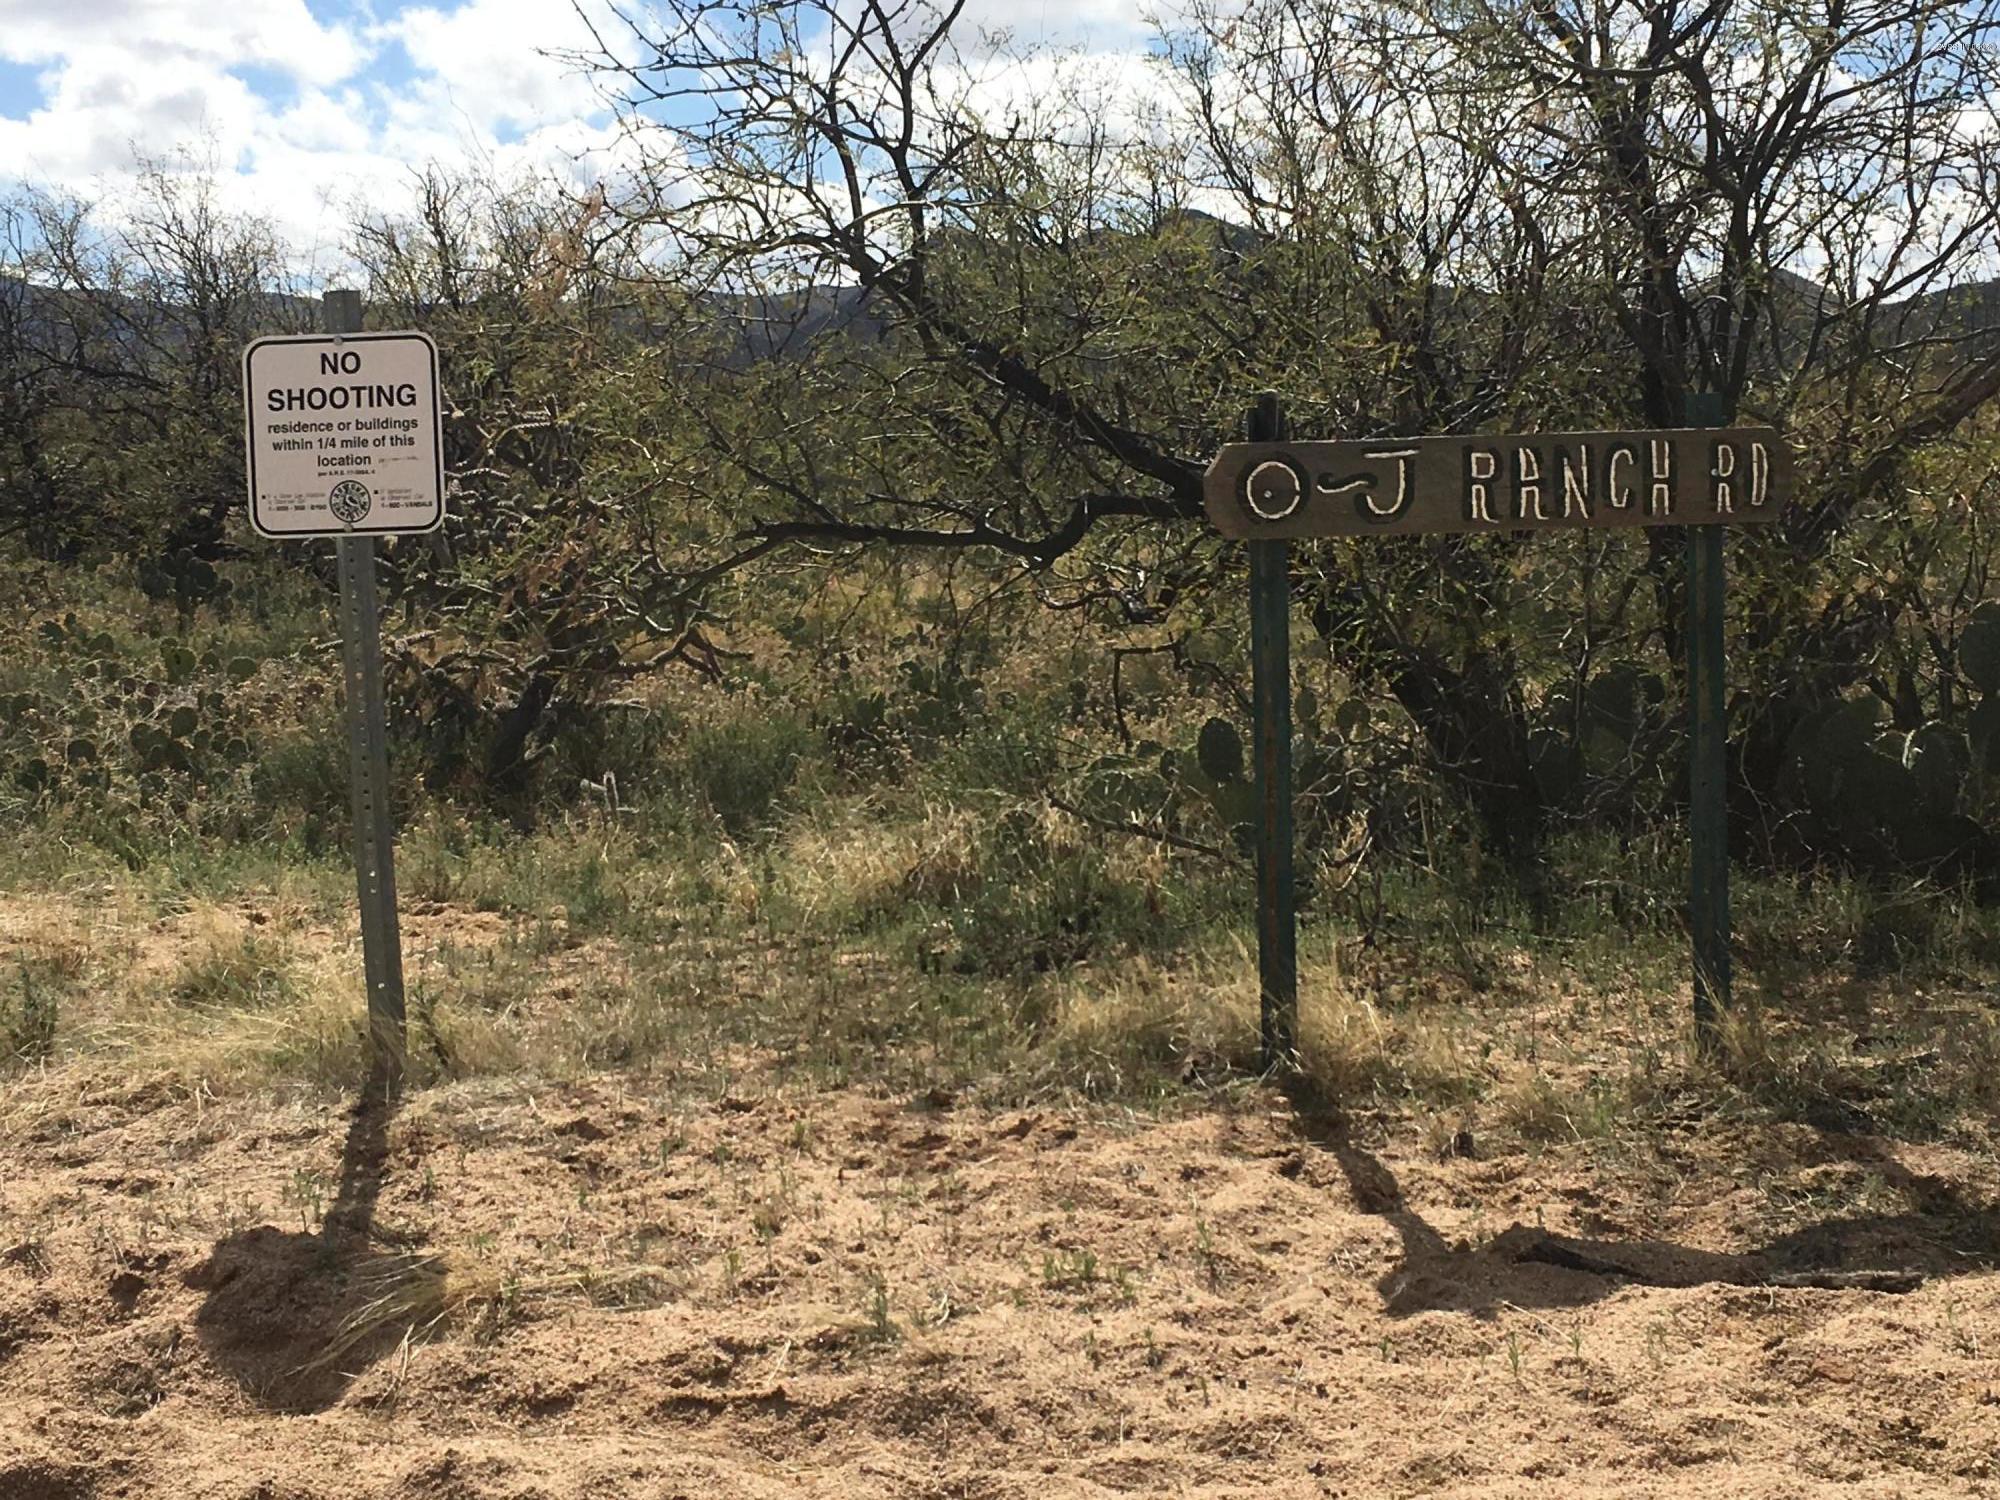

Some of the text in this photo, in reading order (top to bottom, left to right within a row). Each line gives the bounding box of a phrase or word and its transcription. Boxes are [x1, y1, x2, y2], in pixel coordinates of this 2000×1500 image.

[320, 351, 361, 375] NO
[267, 383, 417, 412] SHOOTING
[267, 417, 418, 434] residence or buildings
[272, 434, 415, 451] within 1/4 mile of this
[317, 453, 371, 467] location
[1470, 440, 1671, 524] RANCH
[1715, 442, 1769, 514] RD
